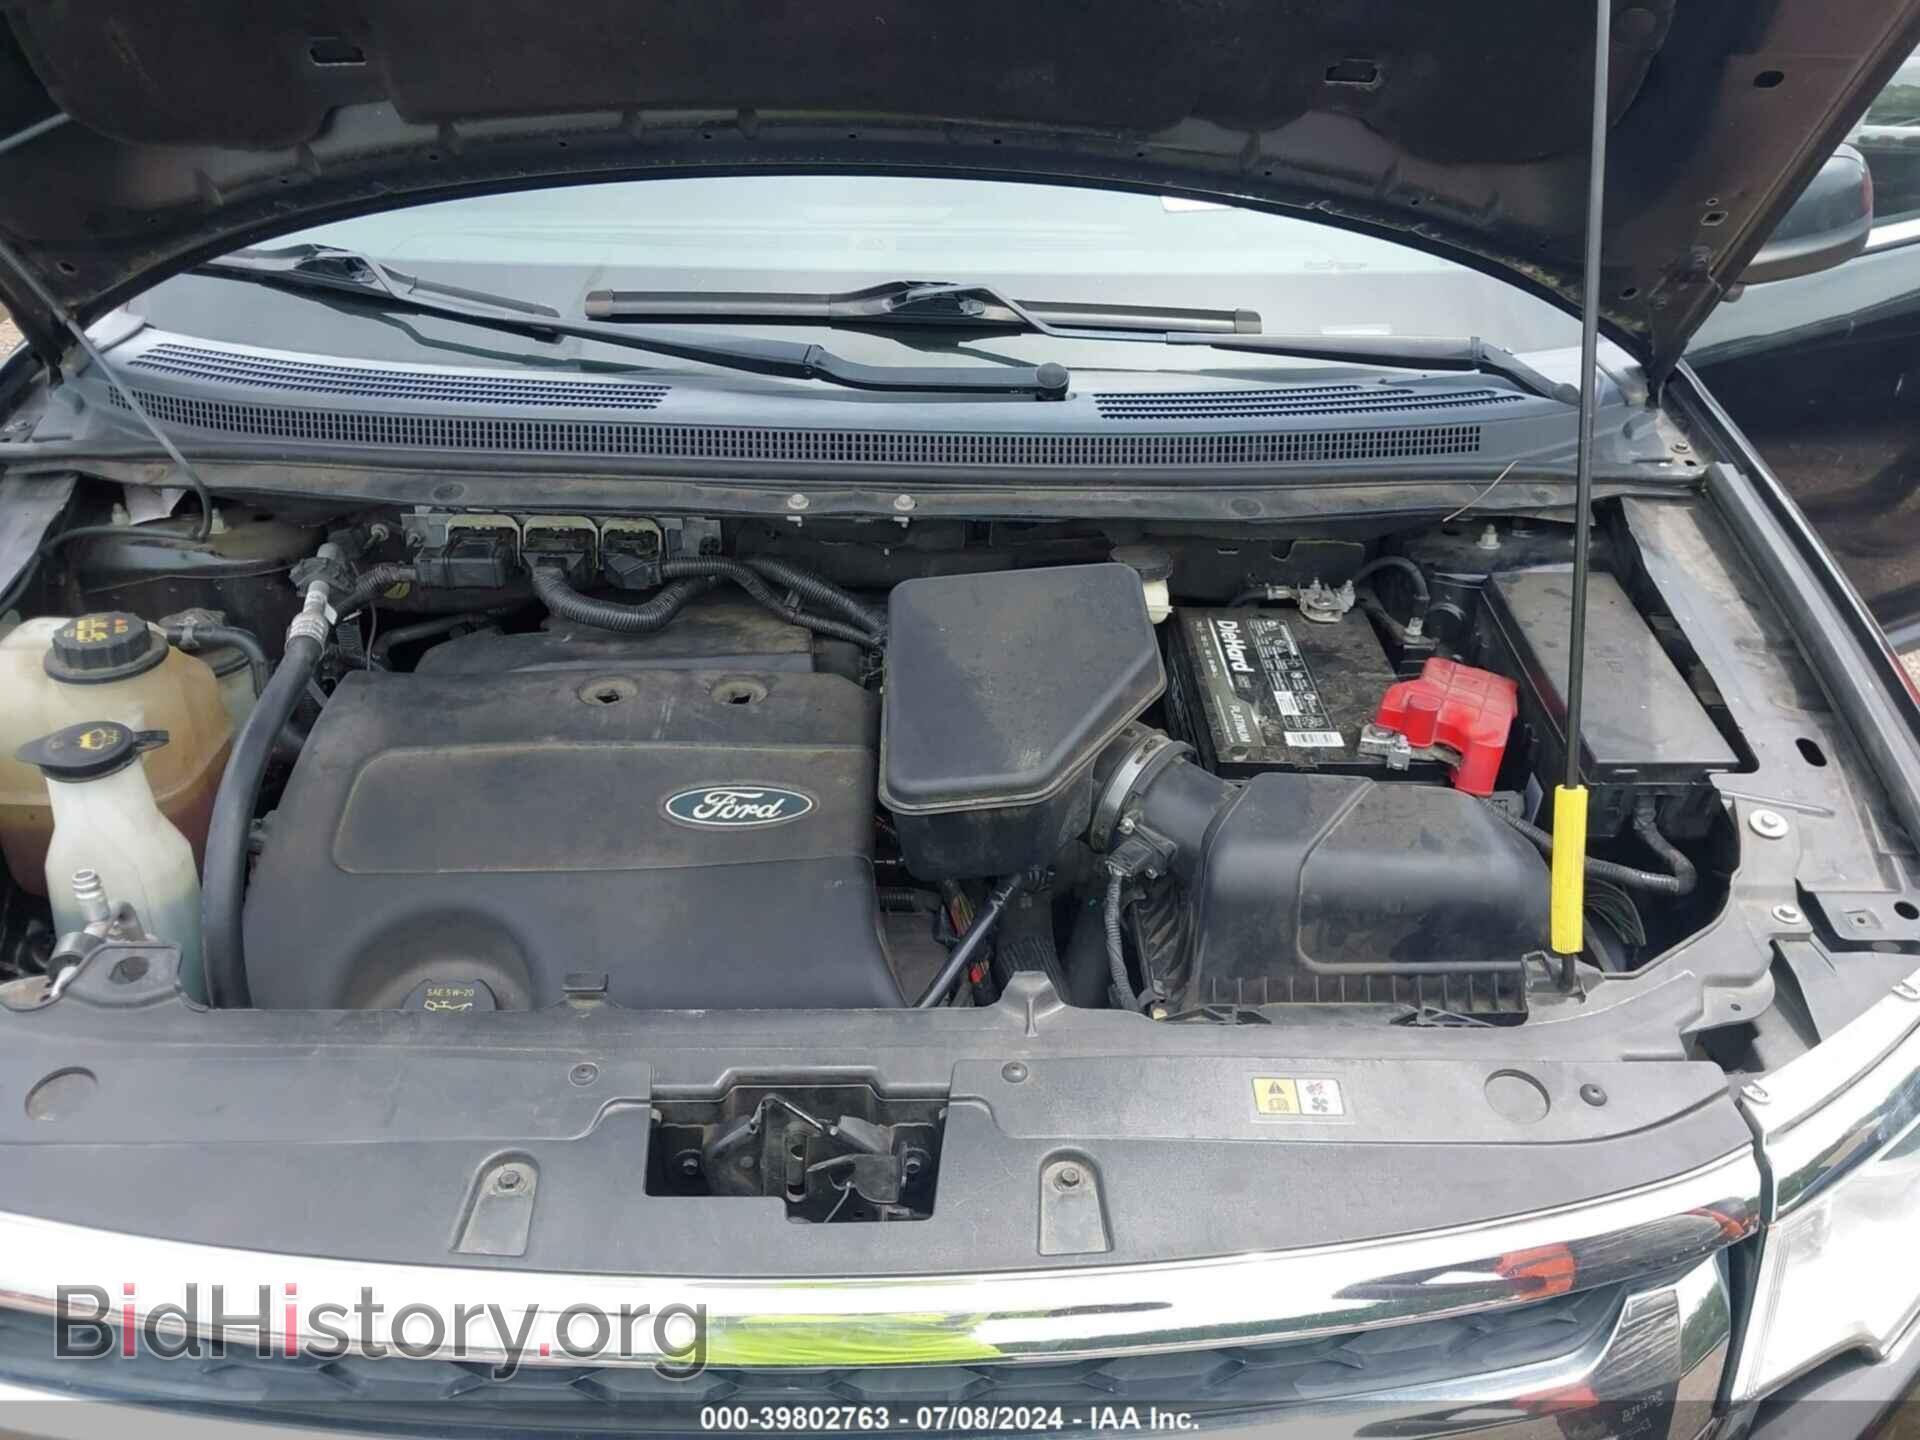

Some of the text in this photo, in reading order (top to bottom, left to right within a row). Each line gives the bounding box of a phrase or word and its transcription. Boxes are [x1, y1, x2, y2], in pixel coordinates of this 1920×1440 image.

[1216, 620, 1255, 672] DieHard
[1229, 704, 1252, 742] PLATINUM
[693, 791, 785, 819] Ford
[426, 987, 446, 997] SAE
